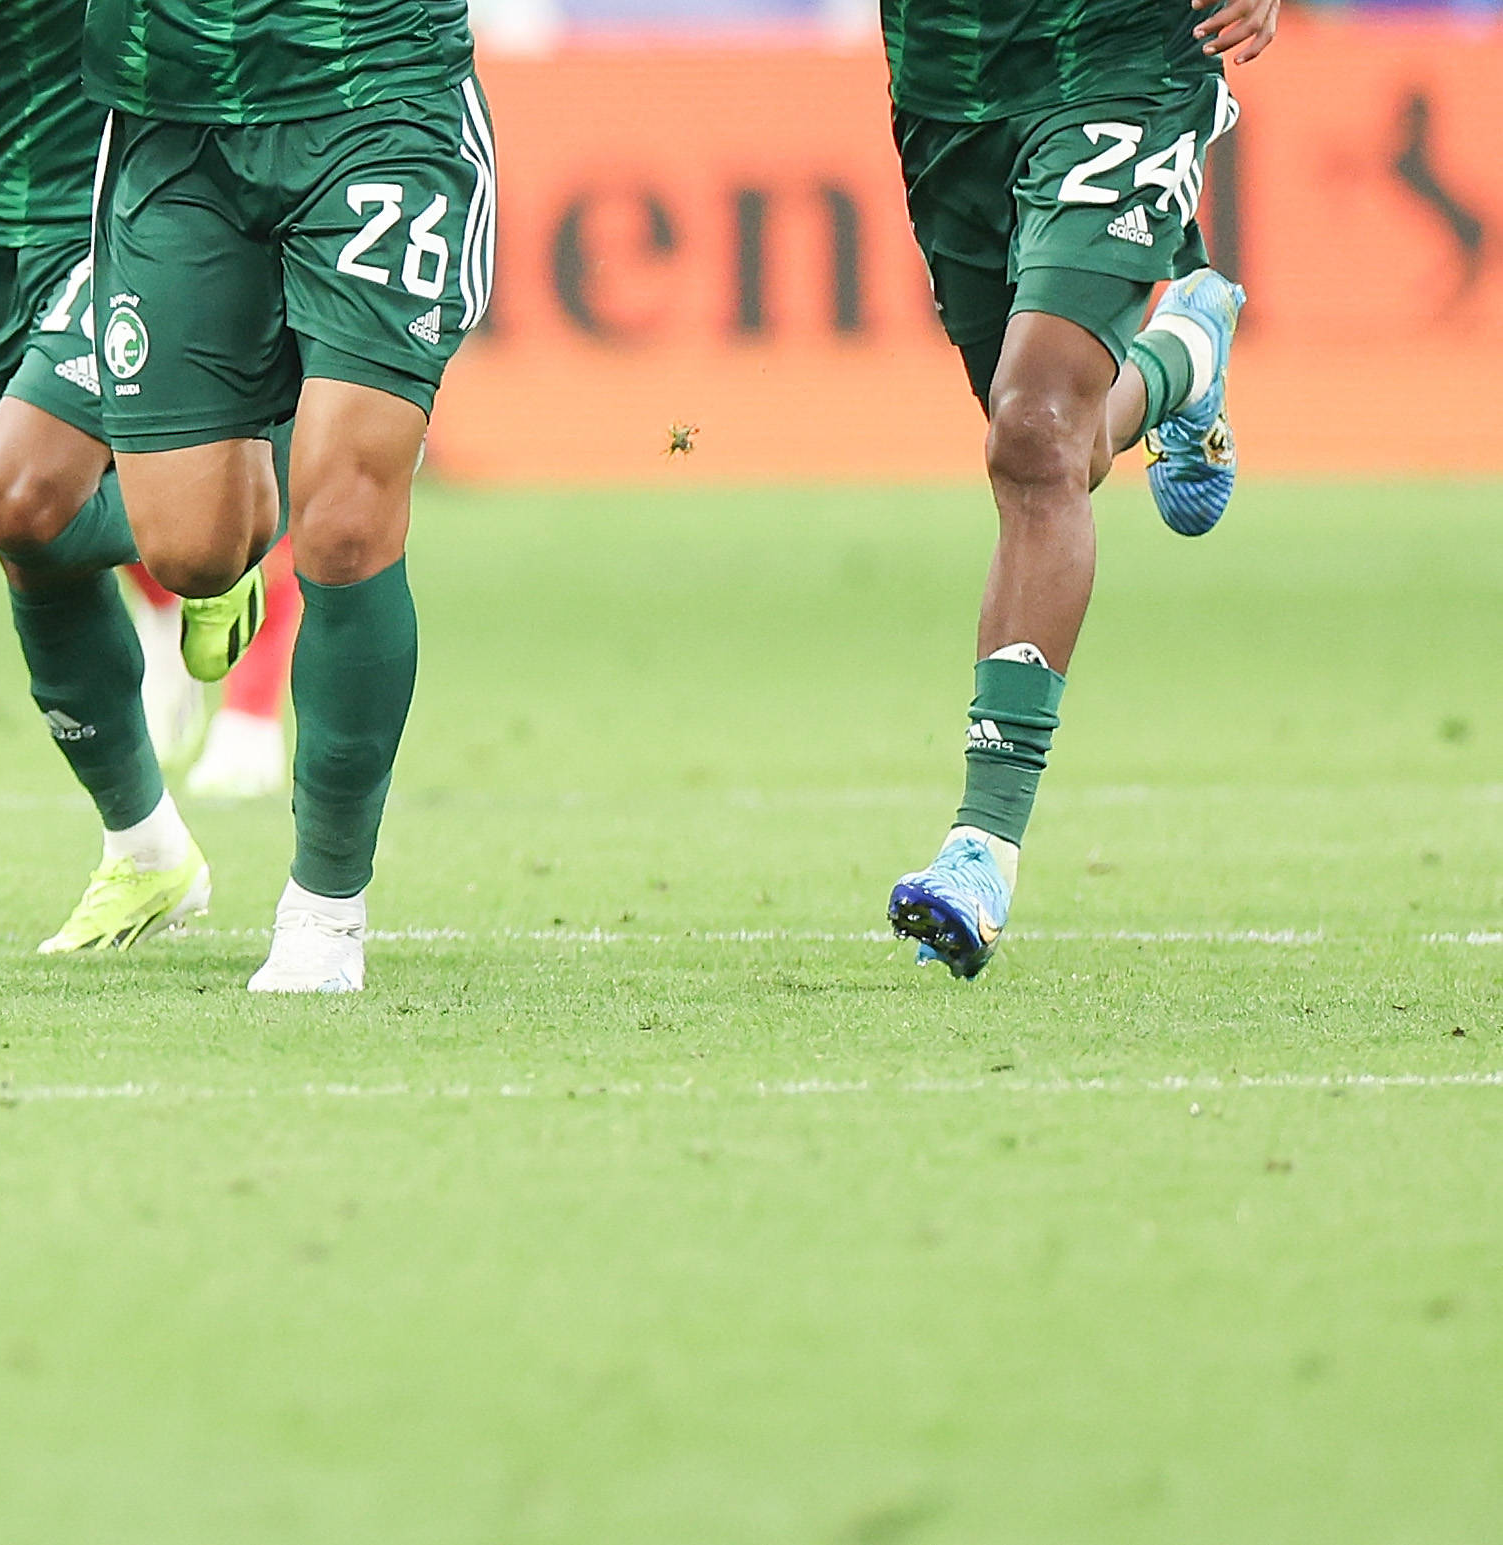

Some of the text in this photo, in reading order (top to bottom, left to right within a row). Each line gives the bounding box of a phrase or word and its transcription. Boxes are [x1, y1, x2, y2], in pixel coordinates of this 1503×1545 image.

[1057, 121, 1197, 213] 24
[336, 182, 450, 301] 26
[1106, 222, 1154, 248] adidas
